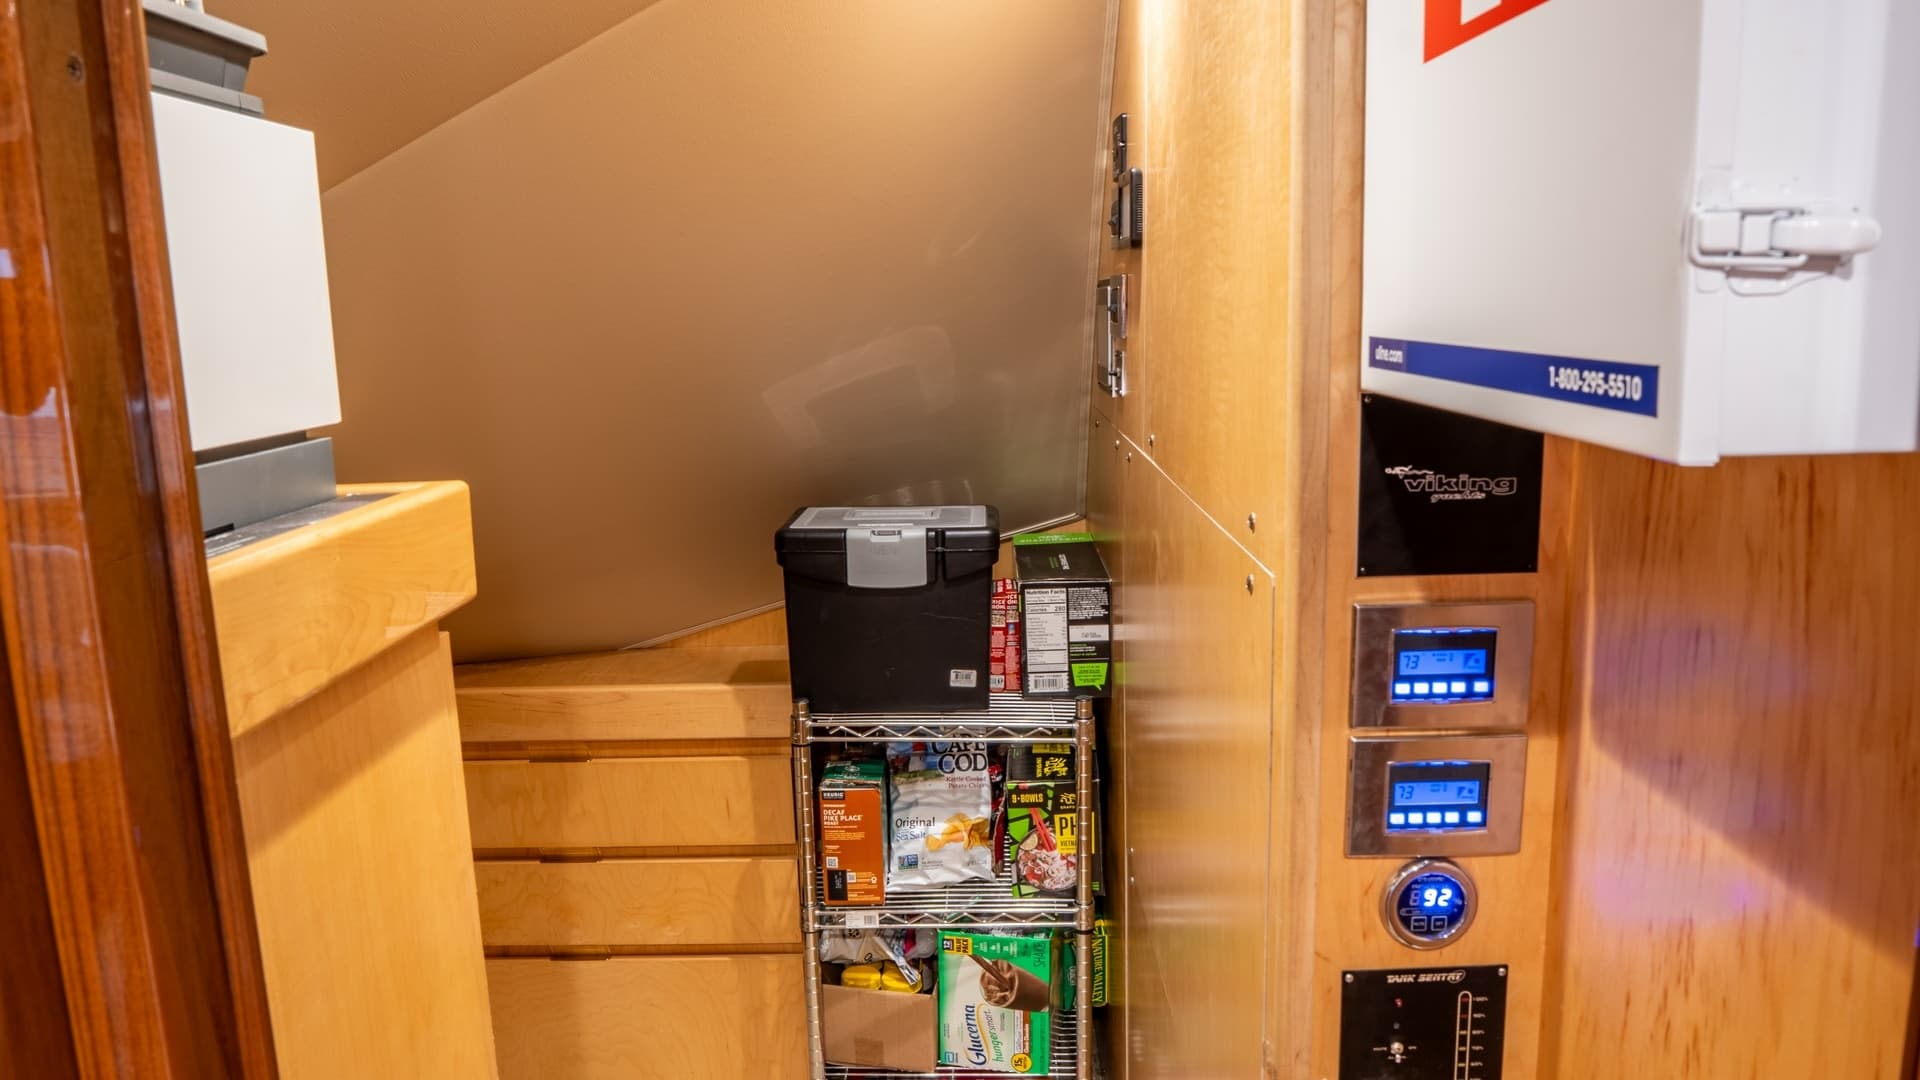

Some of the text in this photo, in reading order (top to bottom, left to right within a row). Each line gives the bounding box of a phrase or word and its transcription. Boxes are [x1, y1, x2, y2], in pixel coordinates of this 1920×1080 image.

[1548, 365, 1643, 402] 1-800-295-5510
[1404, 474, 1517, 496] viking
[1403, 655, 1420, 670] 73
[931, 733, 985, 754] CAPE
[938, 753, 988, 774] COD
[1398, 785, 1415, 800] 73
[895, 816, 936, 829] Original
[1059, 816, 1077, 836] PH
[896, 830, 926, 841] Sea Salt
[1423, 888, 1452, 908] 92
[1091, 937, 1103, 1002] NATURE VALLEY
[1386, 972, 1463, 983] TANK SENTRY
[965, 1004, 987, 1066] Glucerna
